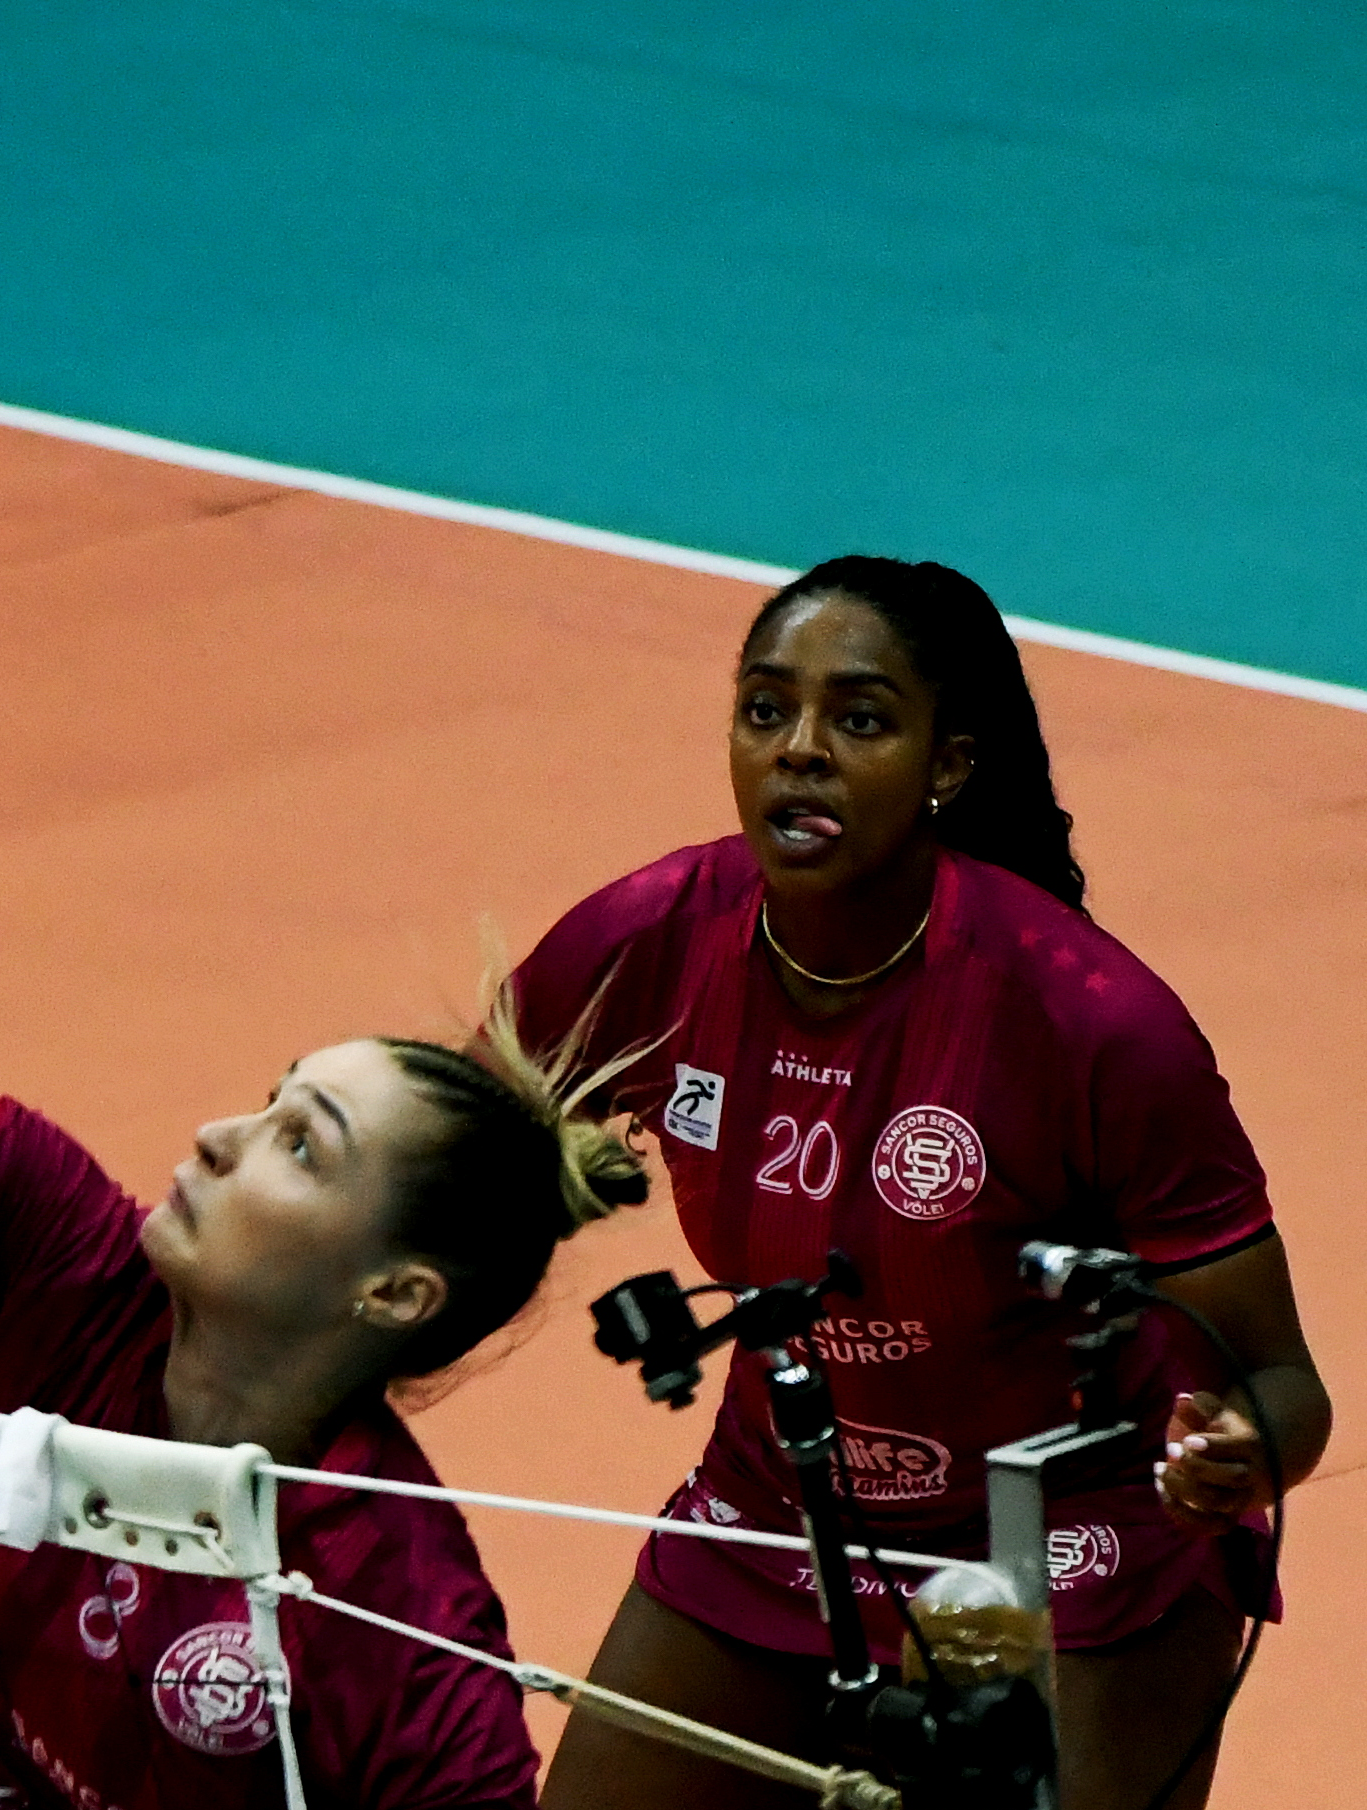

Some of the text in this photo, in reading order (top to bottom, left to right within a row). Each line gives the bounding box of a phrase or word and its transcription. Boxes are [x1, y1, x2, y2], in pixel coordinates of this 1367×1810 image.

[770, 1058, 852, 1087] ATHLETA
[756, 1114, 841, 1200] 20
[881, 1113, 978, 1165] SANCOR SEGUROS
[812, 1317, 928, 1338] NCOR
[78, 1561, 140, 1660] 8
